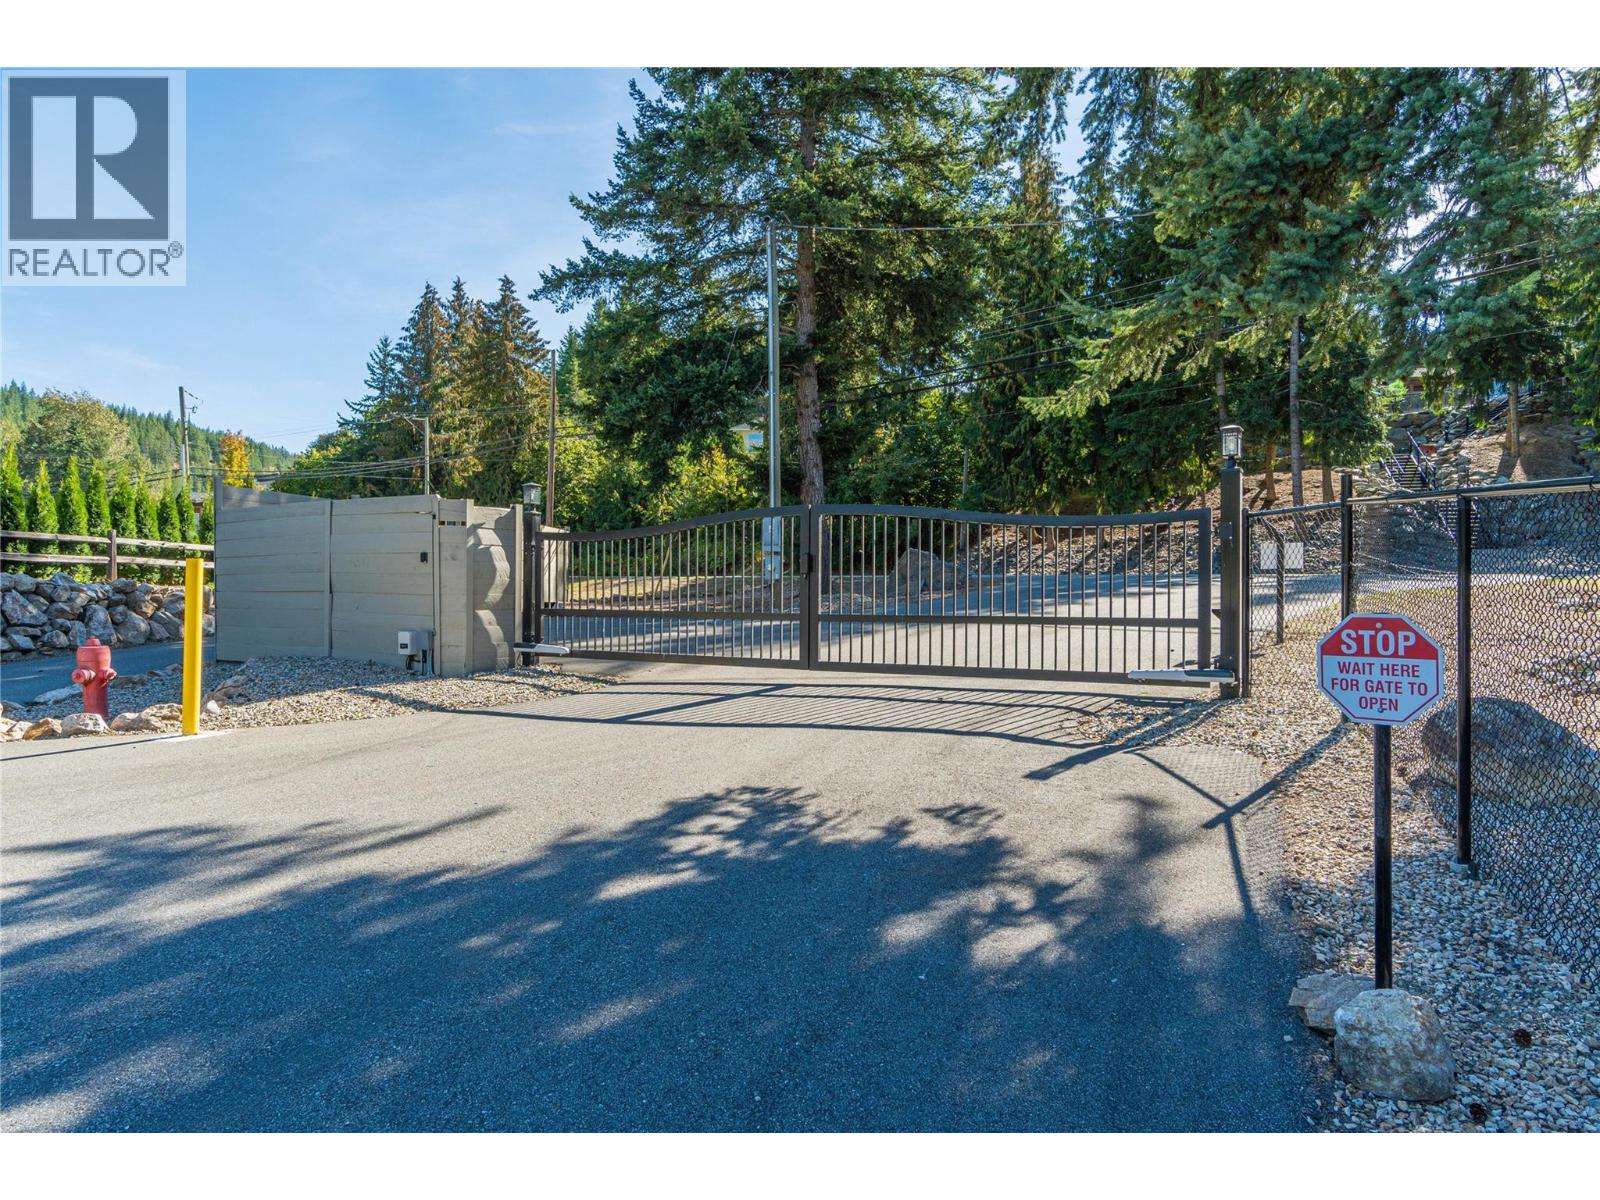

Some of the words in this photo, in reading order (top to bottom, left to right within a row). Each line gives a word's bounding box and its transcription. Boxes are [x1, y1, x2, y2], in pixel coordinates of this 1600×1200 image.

[1340, 629, 1416, 656] STOP
[1337, 661, 1375, 676] WAIT
[1380, 663, 1420, 678] HERE
[1331, 677, 1360, 692] FOR
[1364, 679, 1403, 695] GATE
[1407, 681, 1428, 696] TO
[1359, 696, 1399, 712] OPEN
